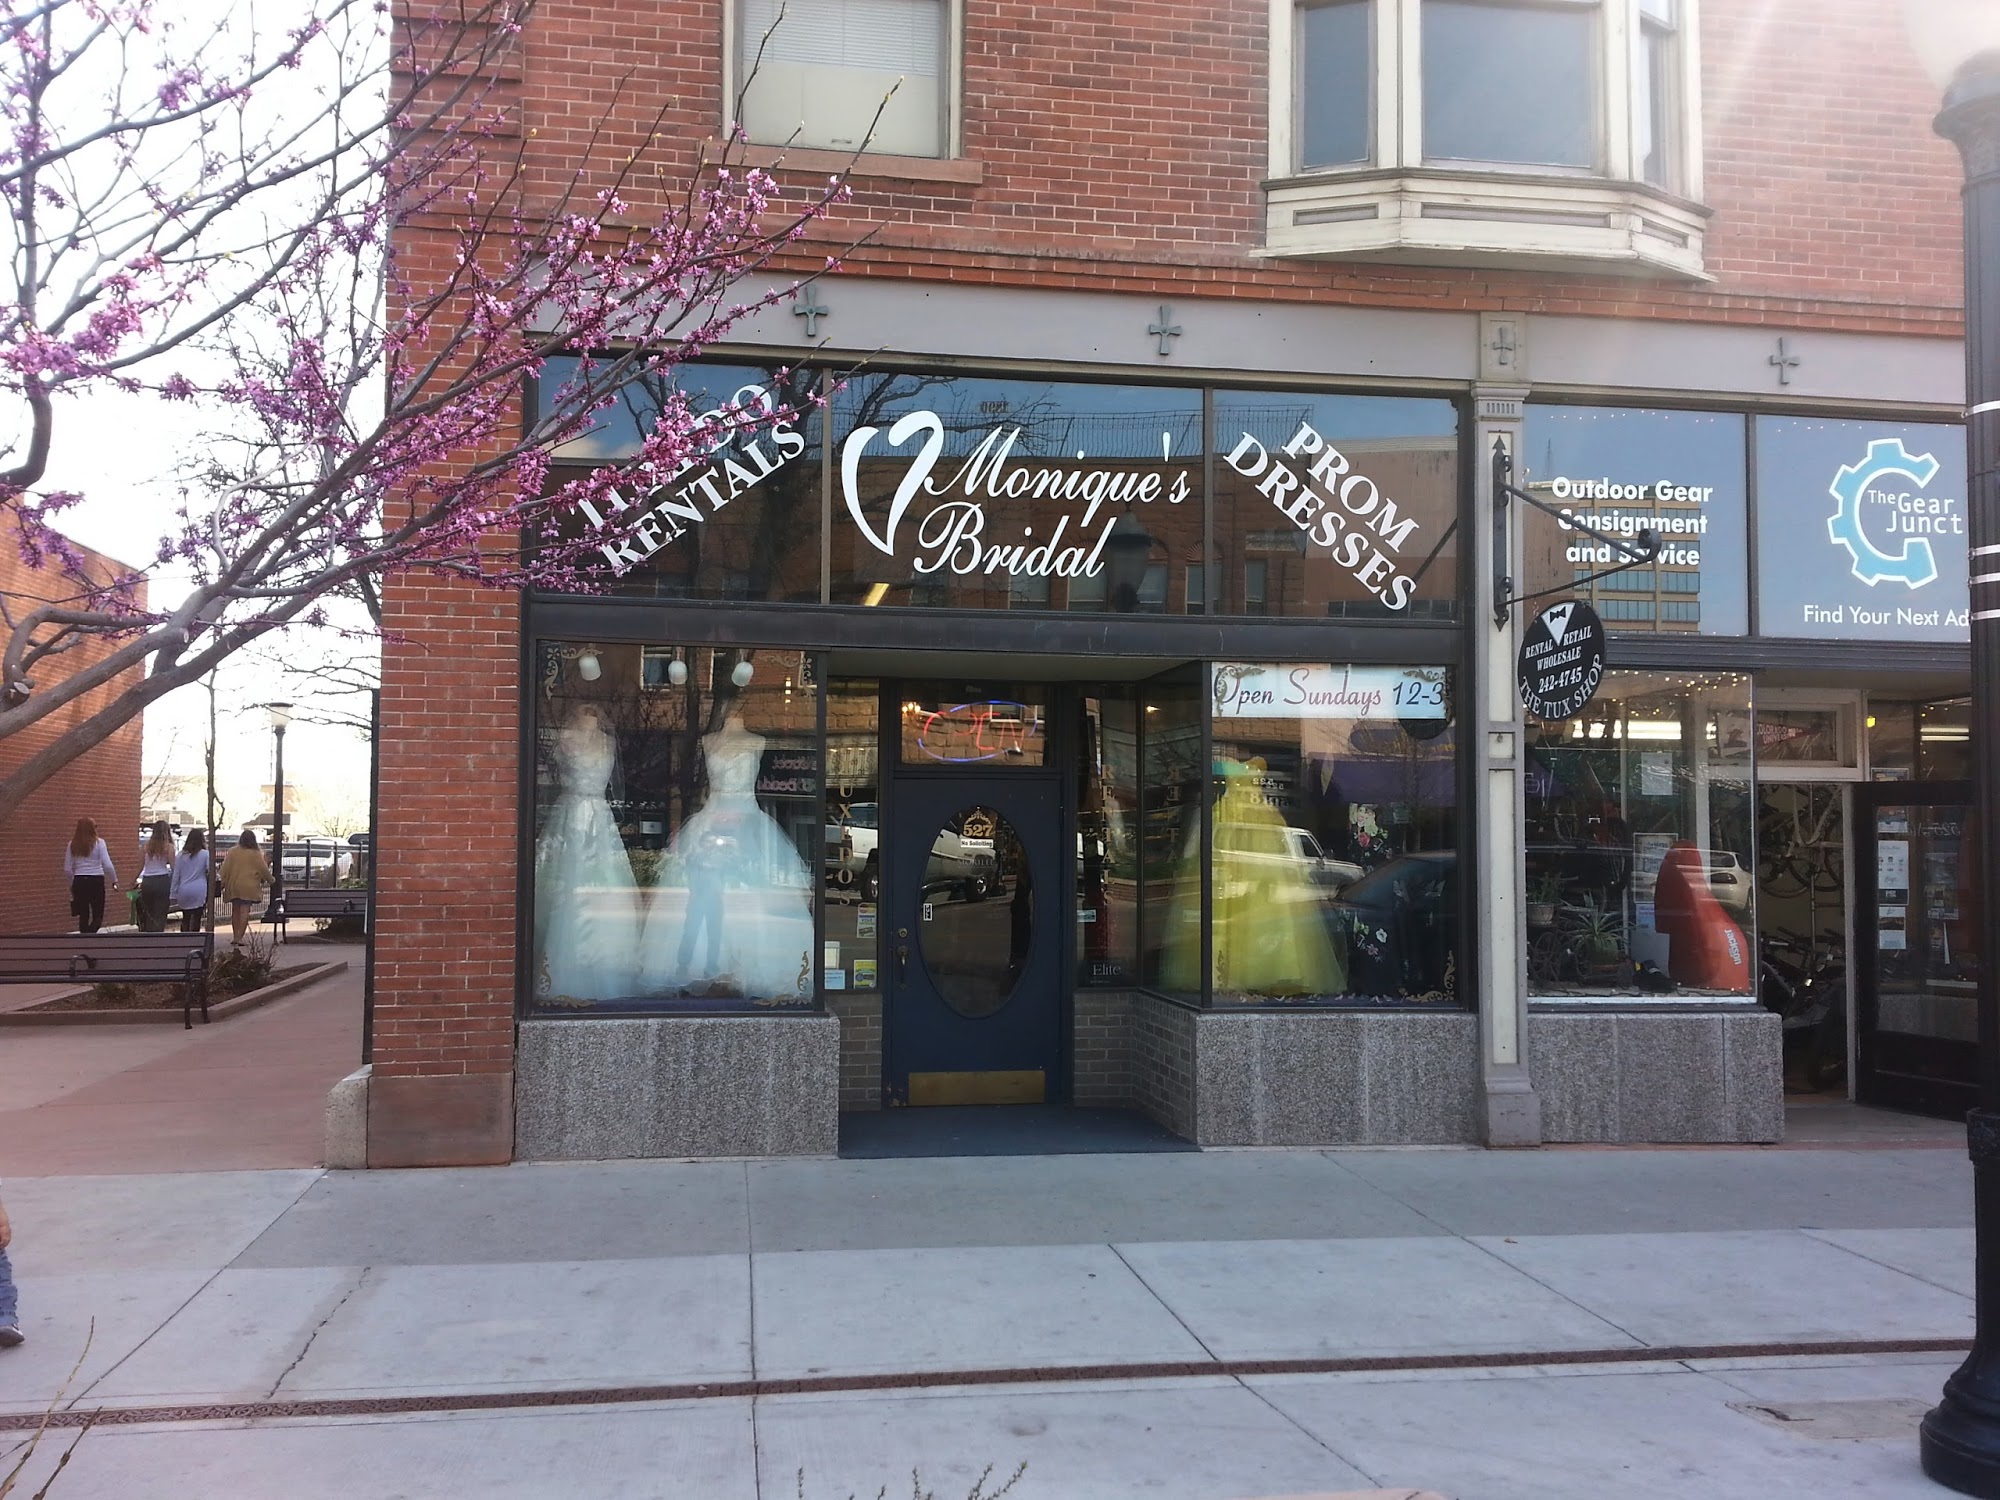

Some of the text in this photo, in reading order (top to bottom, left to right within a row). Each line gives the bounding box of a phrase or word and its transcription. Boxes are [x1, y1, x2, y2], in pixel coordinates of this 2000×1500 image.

[568, 384, 773, 531] TDO
[924, 426, 1191, 528] Monique's
[1281, 421, 1420, 553] PROM
[1552, 476, 1714, 502] Outdoor Gear
[600, 420, 805, 574] RENTALS
[1867, 489, 1954, 514] The Gear
[1223, 431, 1417, 611] DRESSES
[1557, 508, 1708, 537] Consignment
[1885, 511, 1963, 534] Junct
[913, 501, 1118, 578] Bridal
[1566, 543, 1700, 565] and Svice
[1803, 605, 1843, 624] Find
[1849, 606, 1891, 625] Your
[1897, 607, 1939, 626] Next
[1525, 625, 1592, 659] RENTAL RETAIL
[1536, 646, 1581, 671] WHOLESALE
[1213, 665, 1444, 716] Open Sundays 12-3
[1520, 653, 1602, 718] THE TUX SHOP
[1538, 666, 1582, 694] 242-4745
[838, 765, 854, 906] UXEDOS
[963, 824, 993, 837] 527
[969, 840, 993, 848] Soliciting
[1101, 764, 1116, 906] RENTALS
[1092, 963, 1122, 976] Elite
